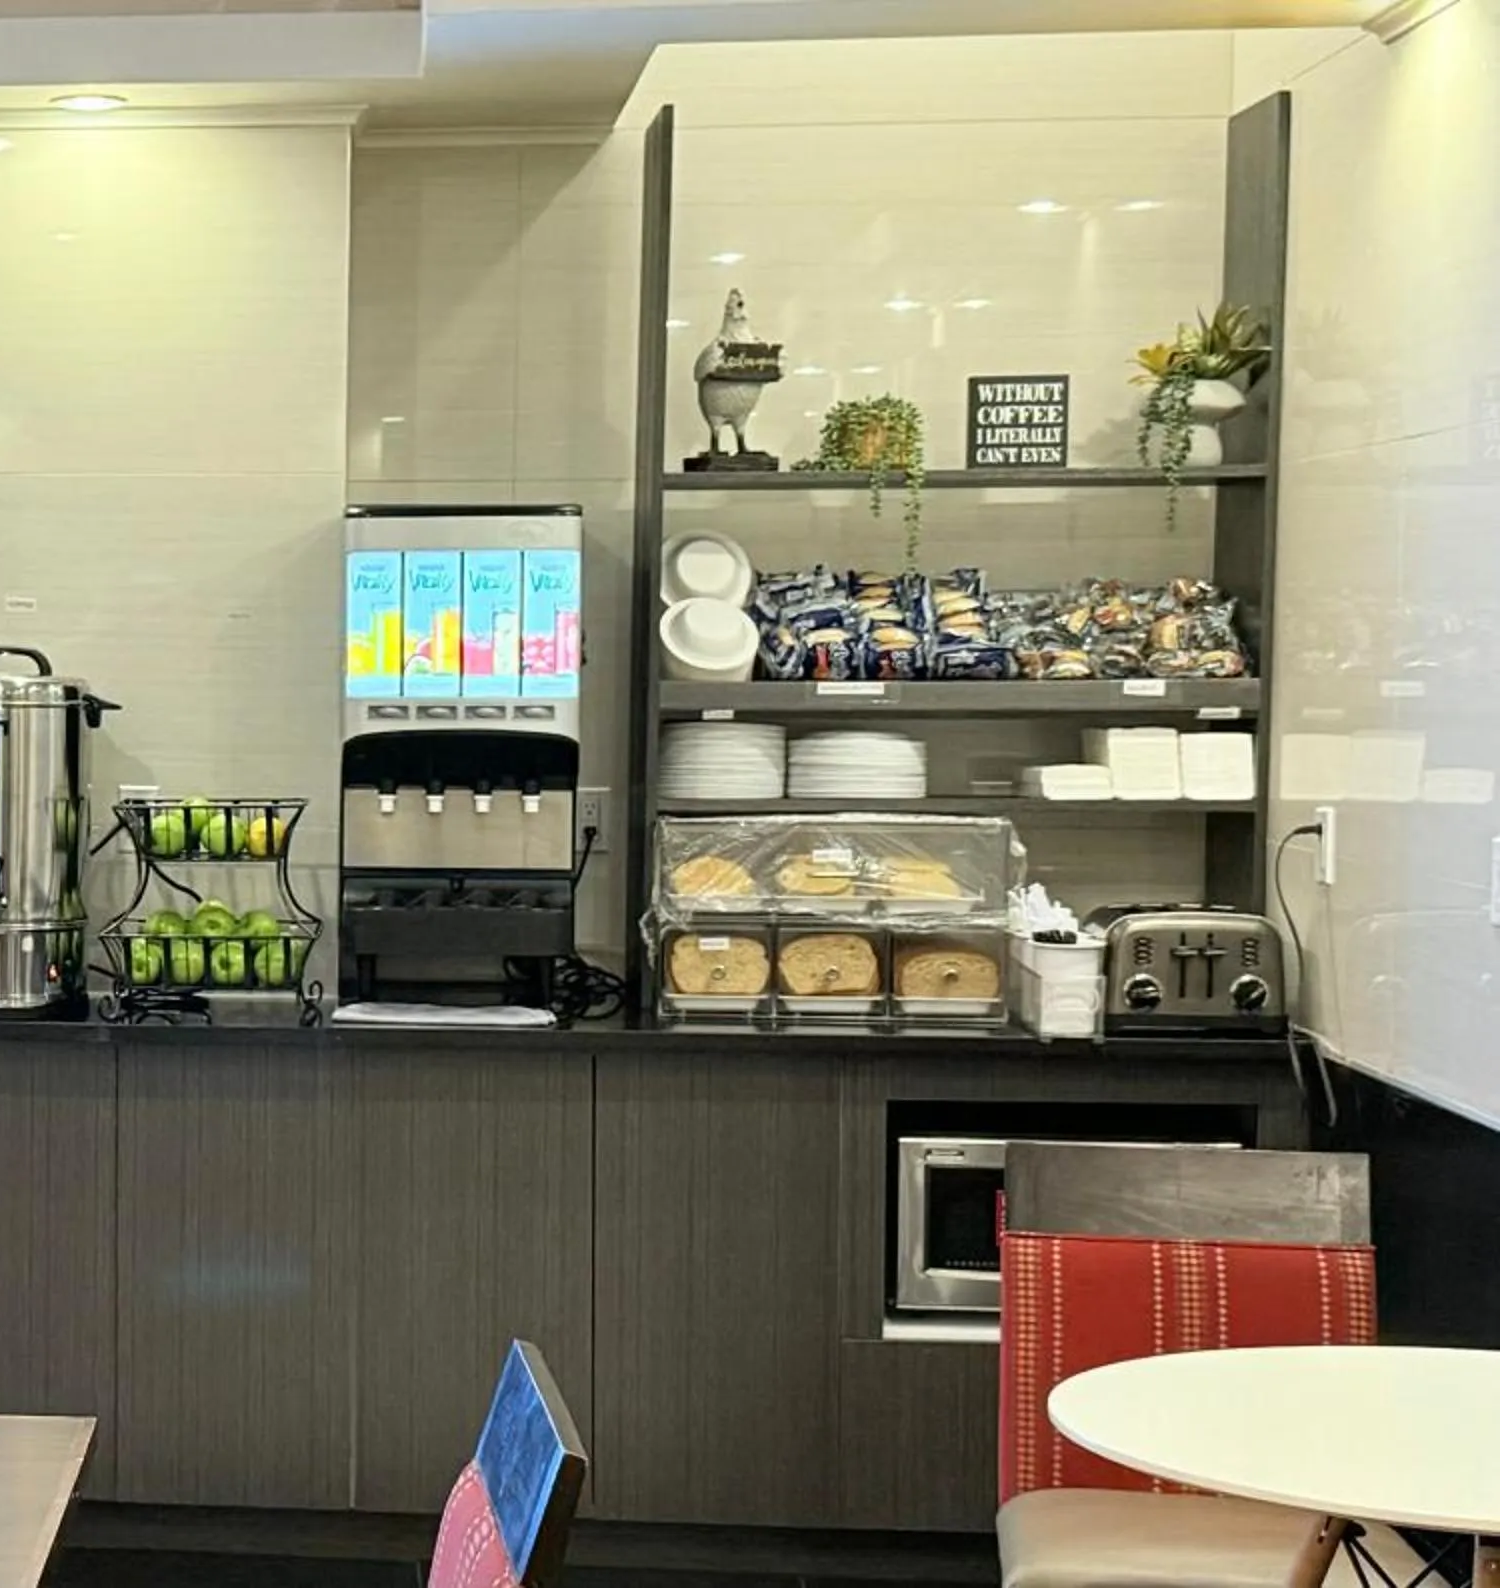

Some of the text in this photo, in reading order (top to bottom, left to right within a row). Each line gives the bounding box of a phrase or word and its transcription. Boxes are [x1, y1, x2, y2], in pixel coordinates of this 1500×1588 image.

[977, 383, 1064, 402] WITHOUT
[977, 405, 1064, 425] COFFEE
[976, 427, 1063, 445] I LITERALLY
[976, 447, 1062, 464] CAN'T EVEN
